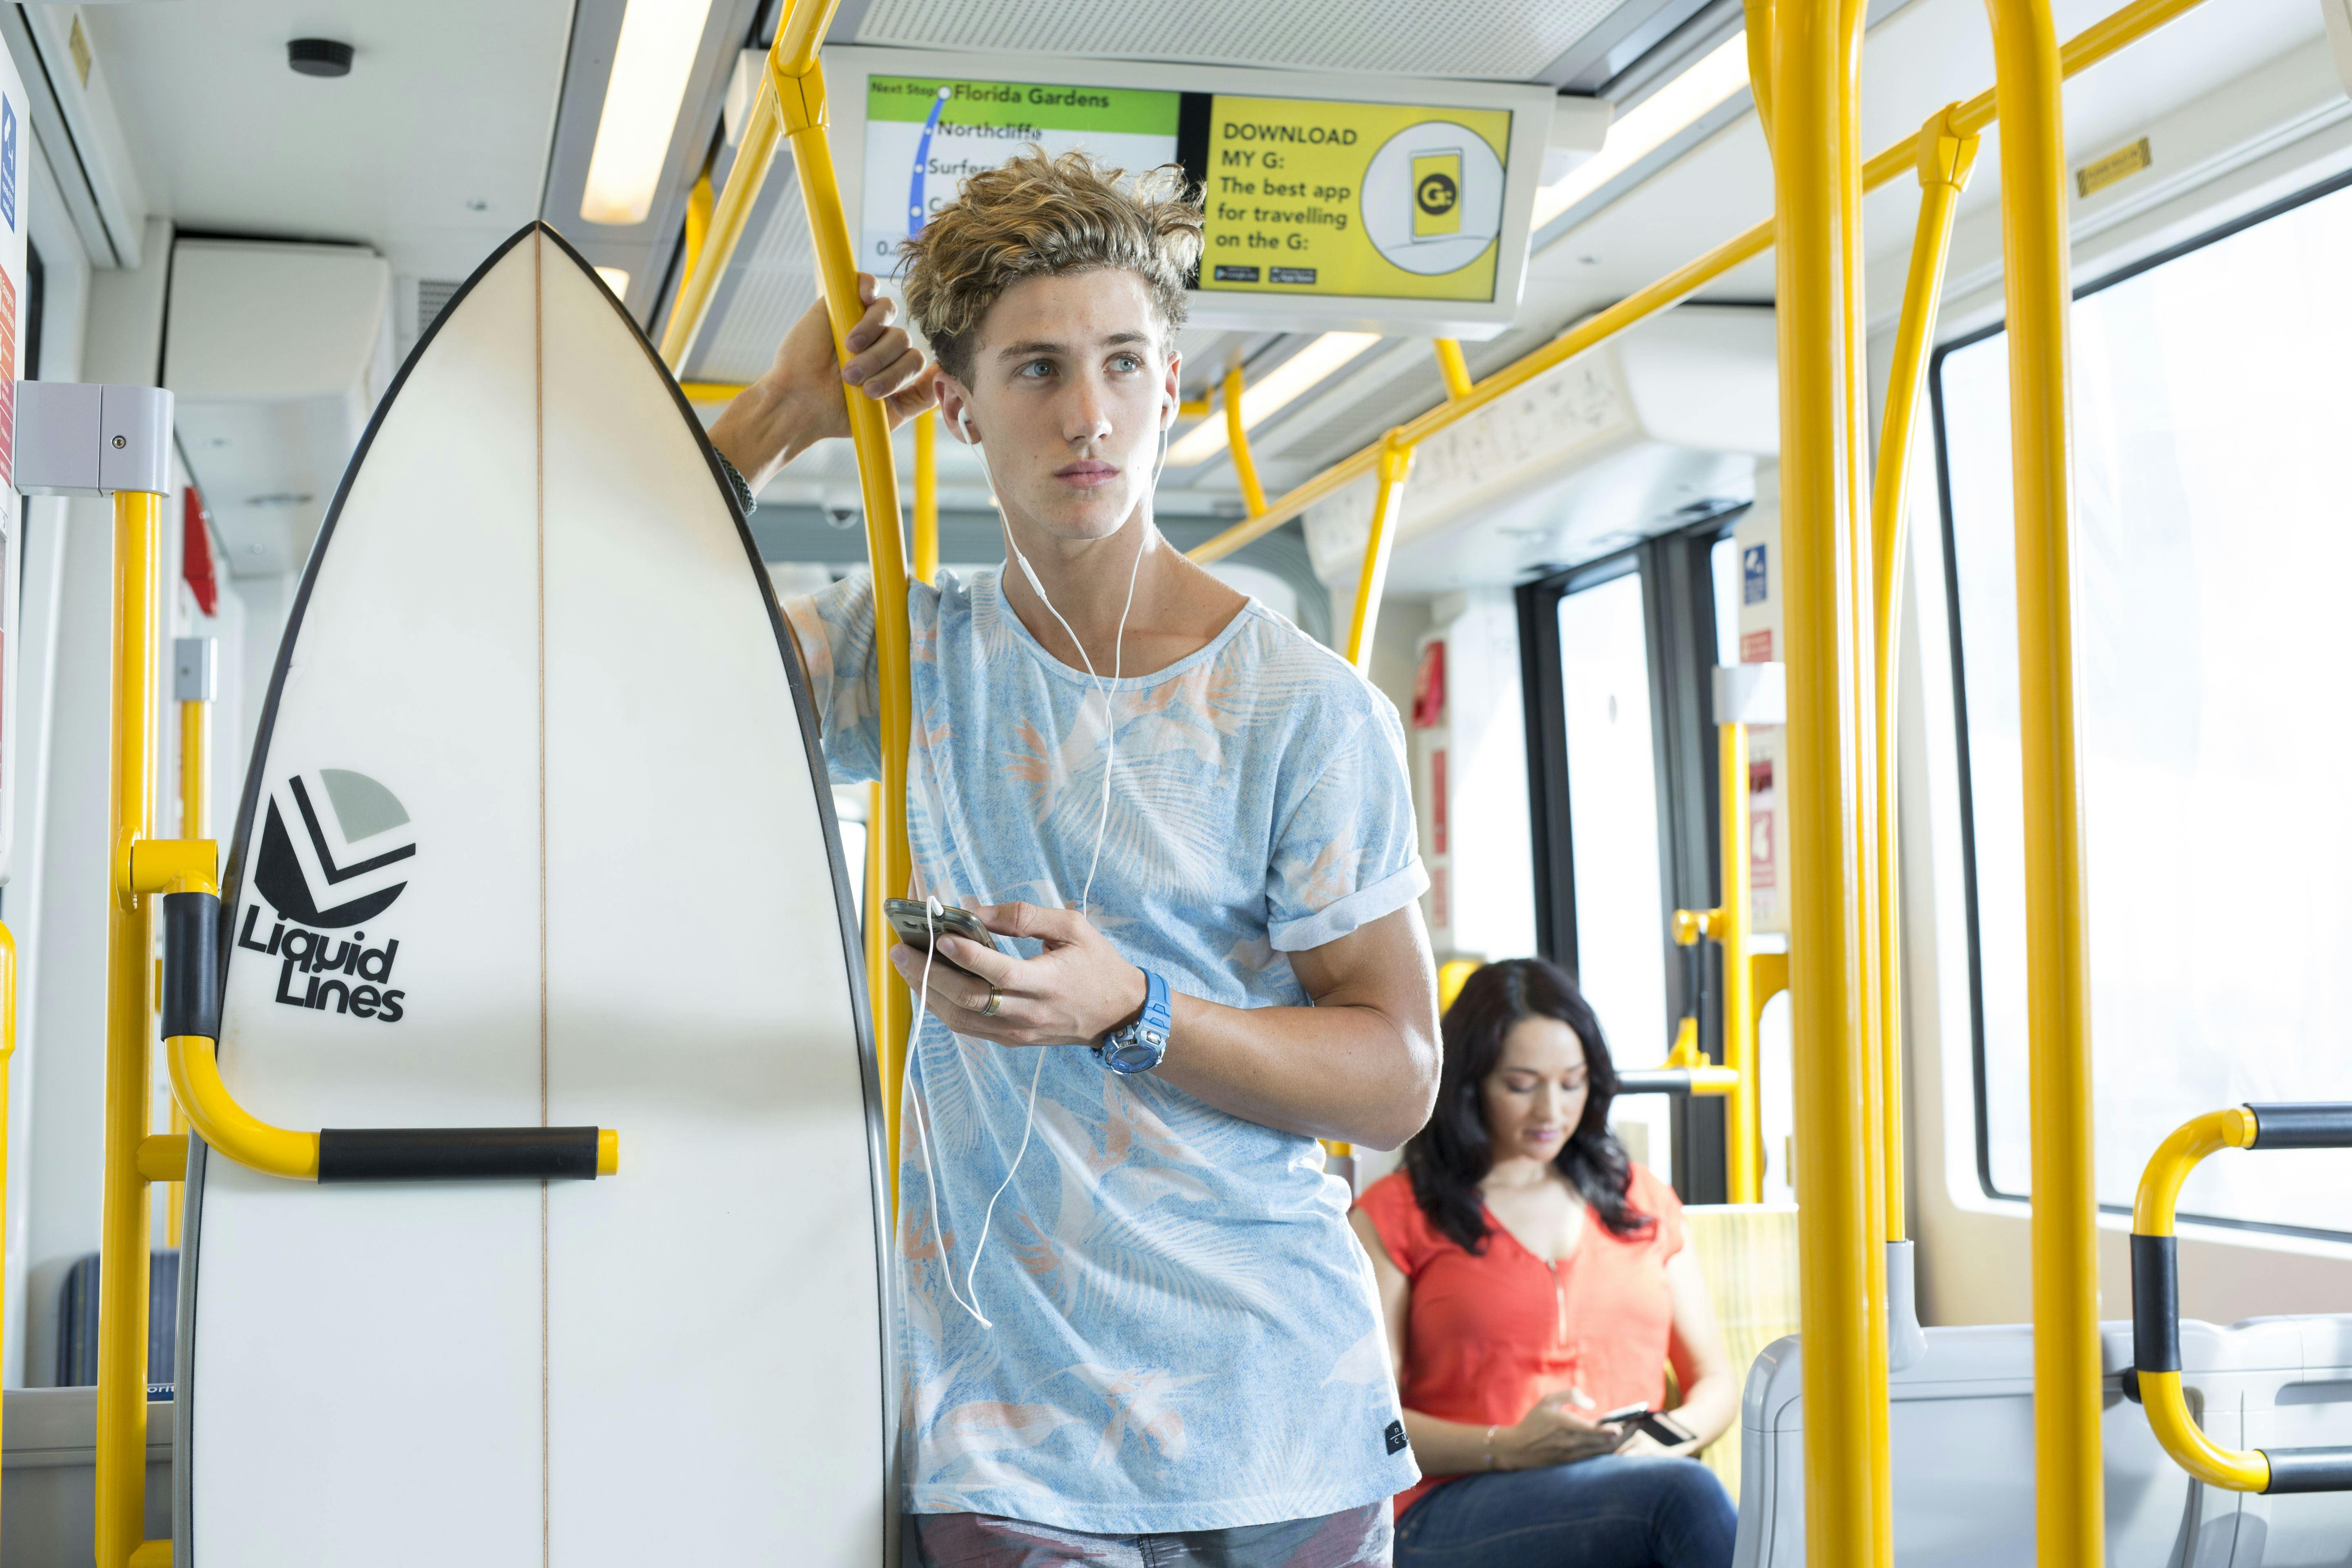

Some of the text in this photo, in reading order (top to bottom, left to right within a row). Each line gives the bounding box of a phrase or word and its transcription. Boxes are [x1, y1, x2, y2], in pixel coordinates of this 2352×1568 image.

[871, 82, 902, 94] Next
[954, 83, 1109, 108] Florida Gardens
[938, 121, 1042, 141] Northcliffe
[1224, 122, 1357, 145] DOWNLOAD
[1222, 150, 1284, 169] MY G:
[1219, 176, 1351, 203] The best app
[1218, 202, 1347, 230] for travelling
[1216, 231, 1308, 250] on the G:
[238, 904, 399, 984] Liquid
[275, 959, 405, 1022] Lines
